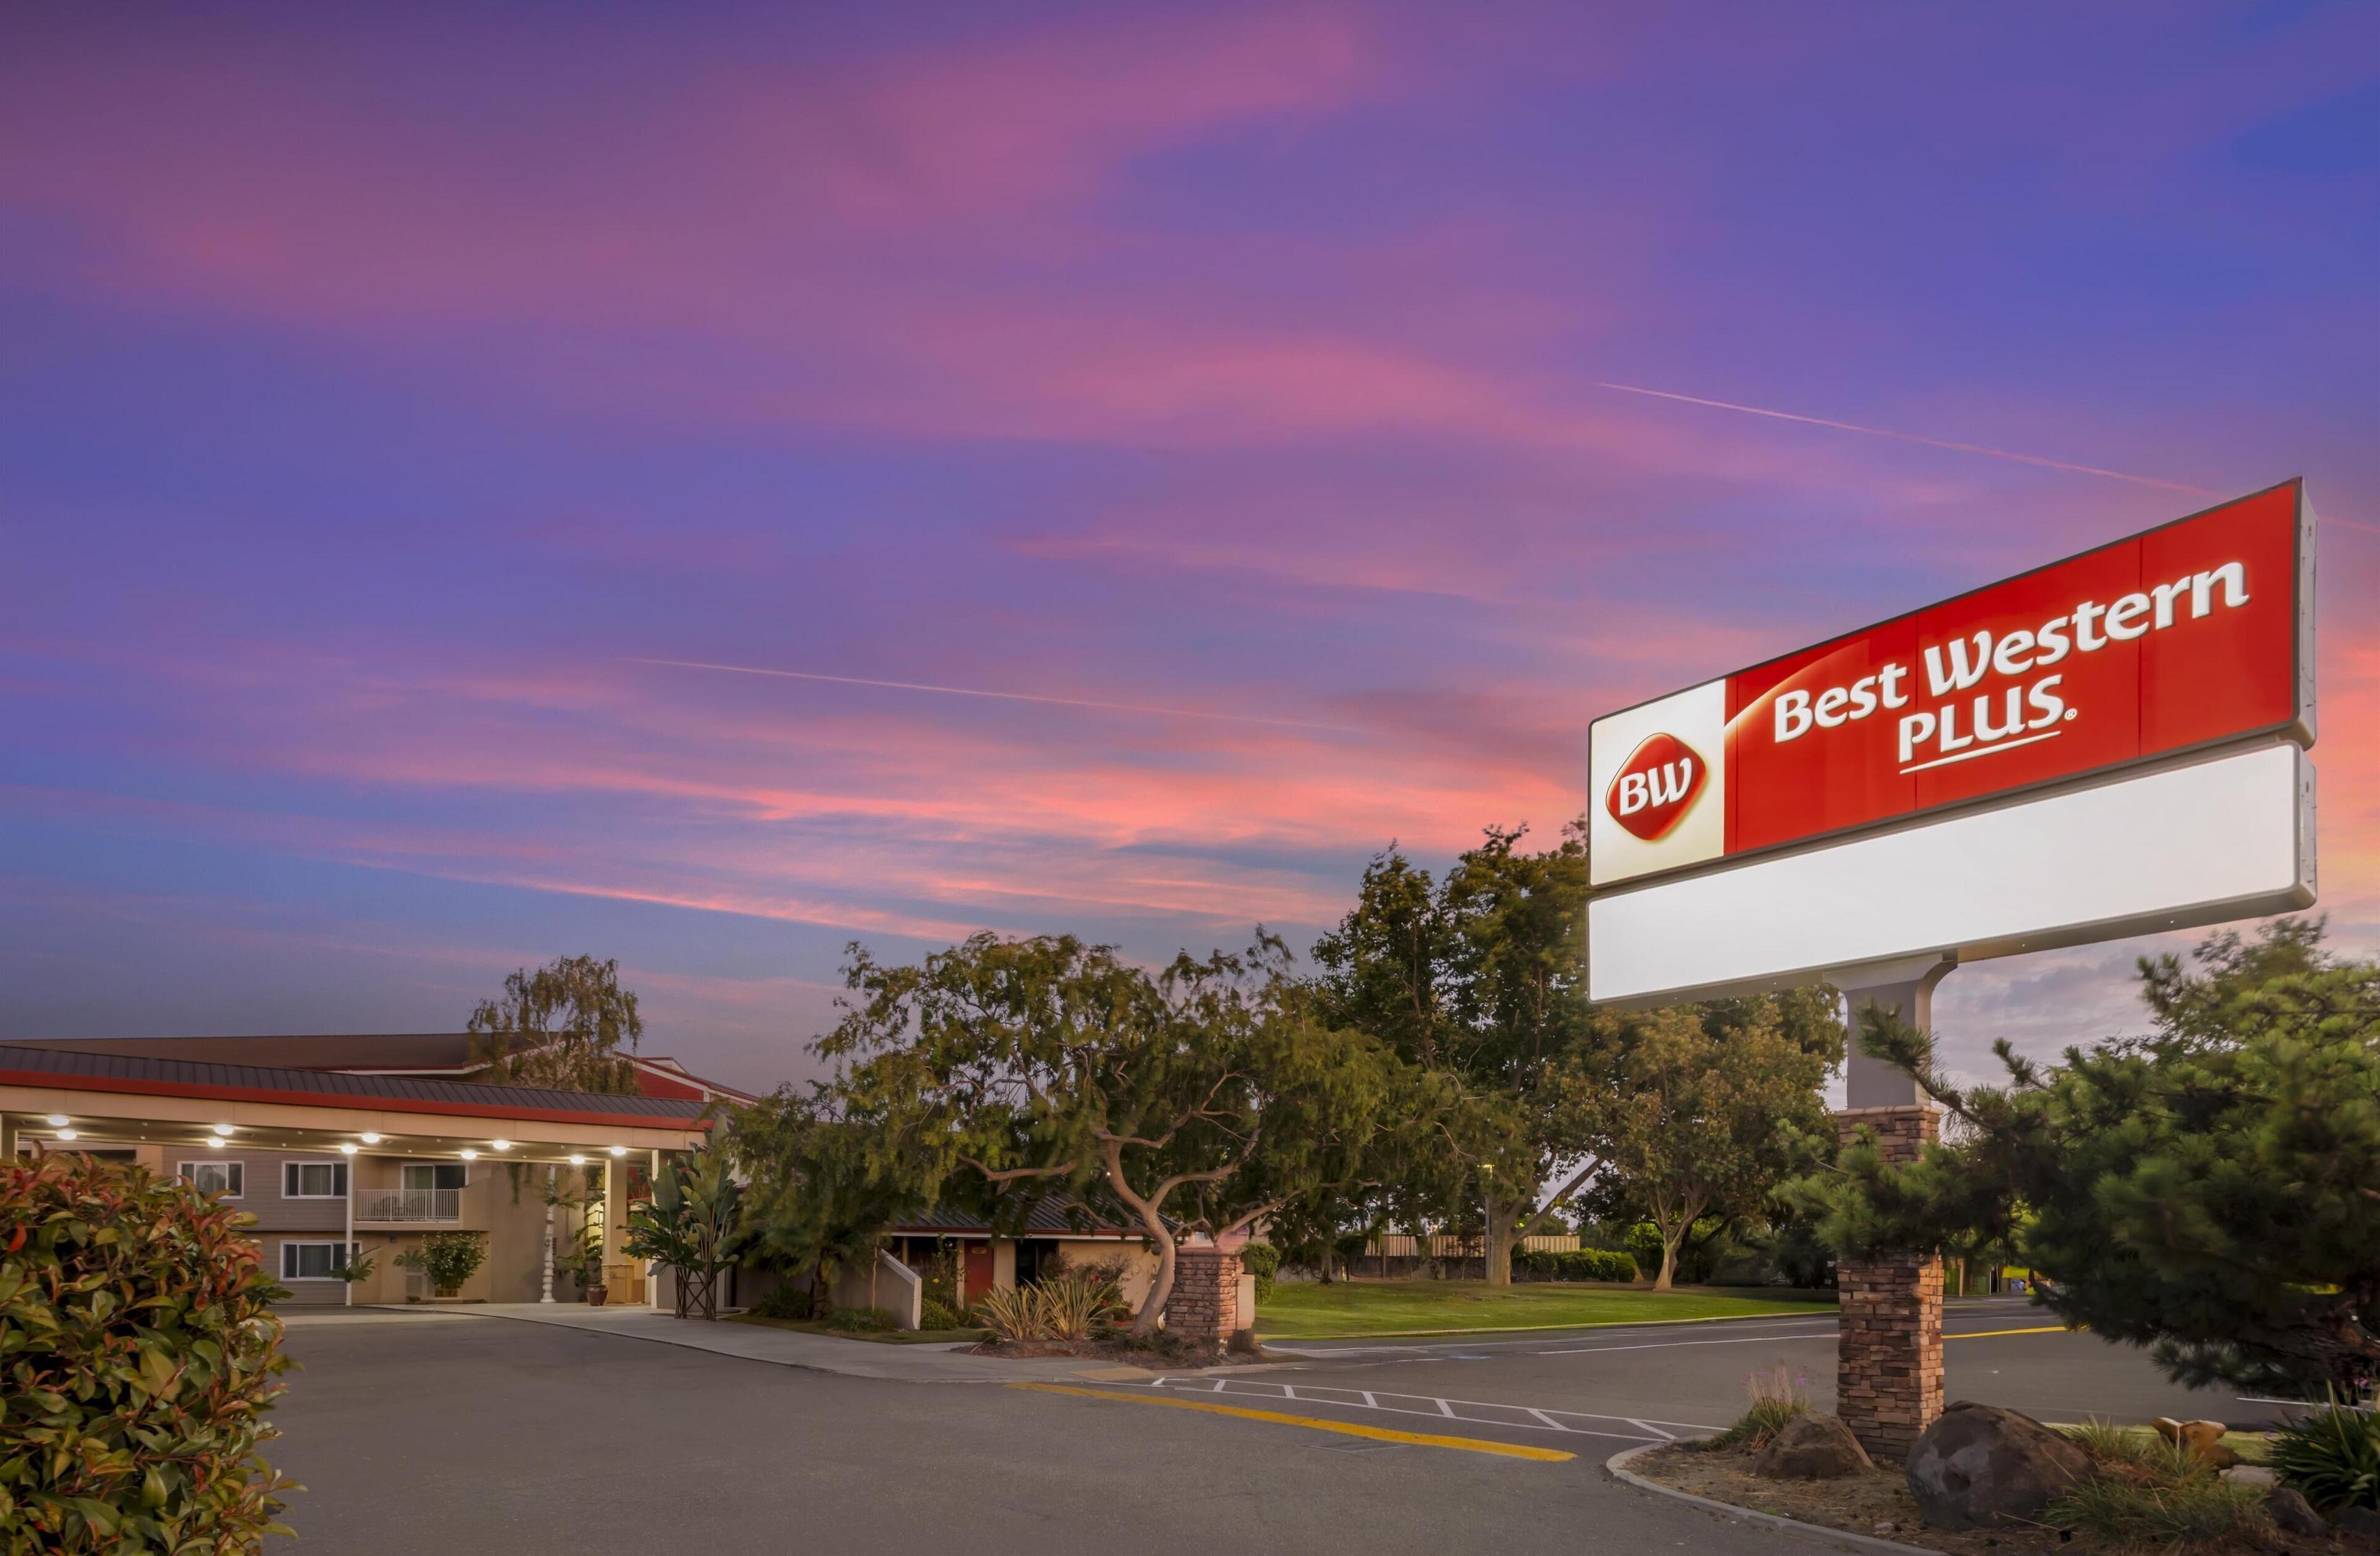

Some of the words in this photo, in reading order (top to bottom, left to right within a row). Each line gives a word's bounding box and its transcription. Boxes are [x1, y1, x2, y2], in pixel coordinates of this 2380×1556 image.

[1775, 662, 1909, 743] Best
[1924, 561, 2250, 696] Western
[1620, 757, 1693, 816] BW
